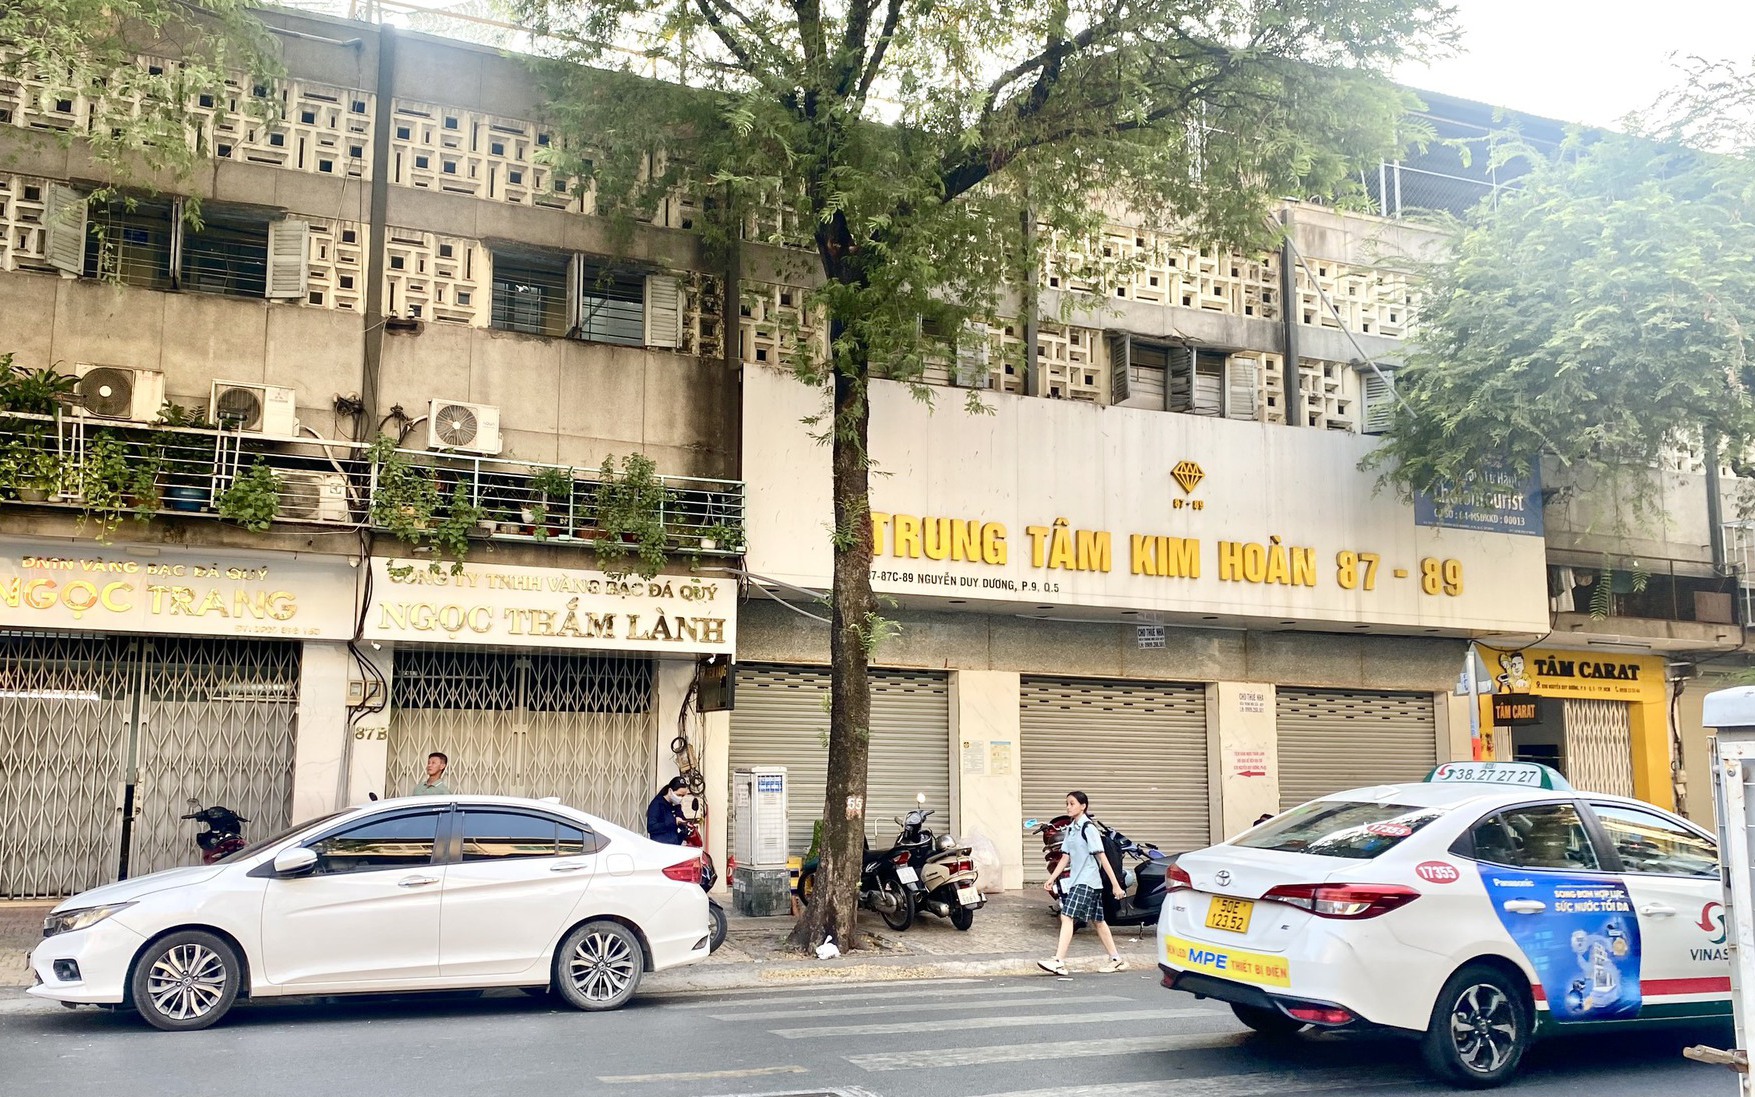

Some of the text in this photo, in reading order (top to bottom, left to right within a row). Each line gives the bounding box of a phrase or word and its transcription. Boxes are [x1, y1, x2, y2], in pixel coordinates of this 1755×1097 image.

[1173, 498, 1183, 509] 87
[1192, 499, 1204, 511] 89
[870, 511, 1008, 566] TRUNG
[1025, 516, 1112, 573] TÂM
[1130, 533, 1200, 579] KIM
[1218, 535, 1317, 586] HOÀN
[1336, 551, 1380, 591] 87
[1421, 556, 1464, 597] 89
[455, 571, 481, 587] TY
[486, 573, 543, 591] TNHH
[546, 573, 601, 595] VÀNG
[605, 580, 644, 600] BẠC
[648, 580, 674, 598] ĐÁ
[917, 571, 957, 586] NGUYỄN
[960, 577, 979, 588] DUY
[0, 577, 298, 621] NGỌC TRANG
[378, 602, 494, 640] NGỌC
[626, 605, 726, 644] LÀNH
[1534, 654, 1640, 681] TÂM CARAT
[1512, 704, 1536, 719] CARAT
[1418, 865, 1457, 879] 17355
[1220, 900, 1241, 914] 50E
[1212, 913, 1244, 930] 123.52
[1189, 948, 1229, 970] MPE
